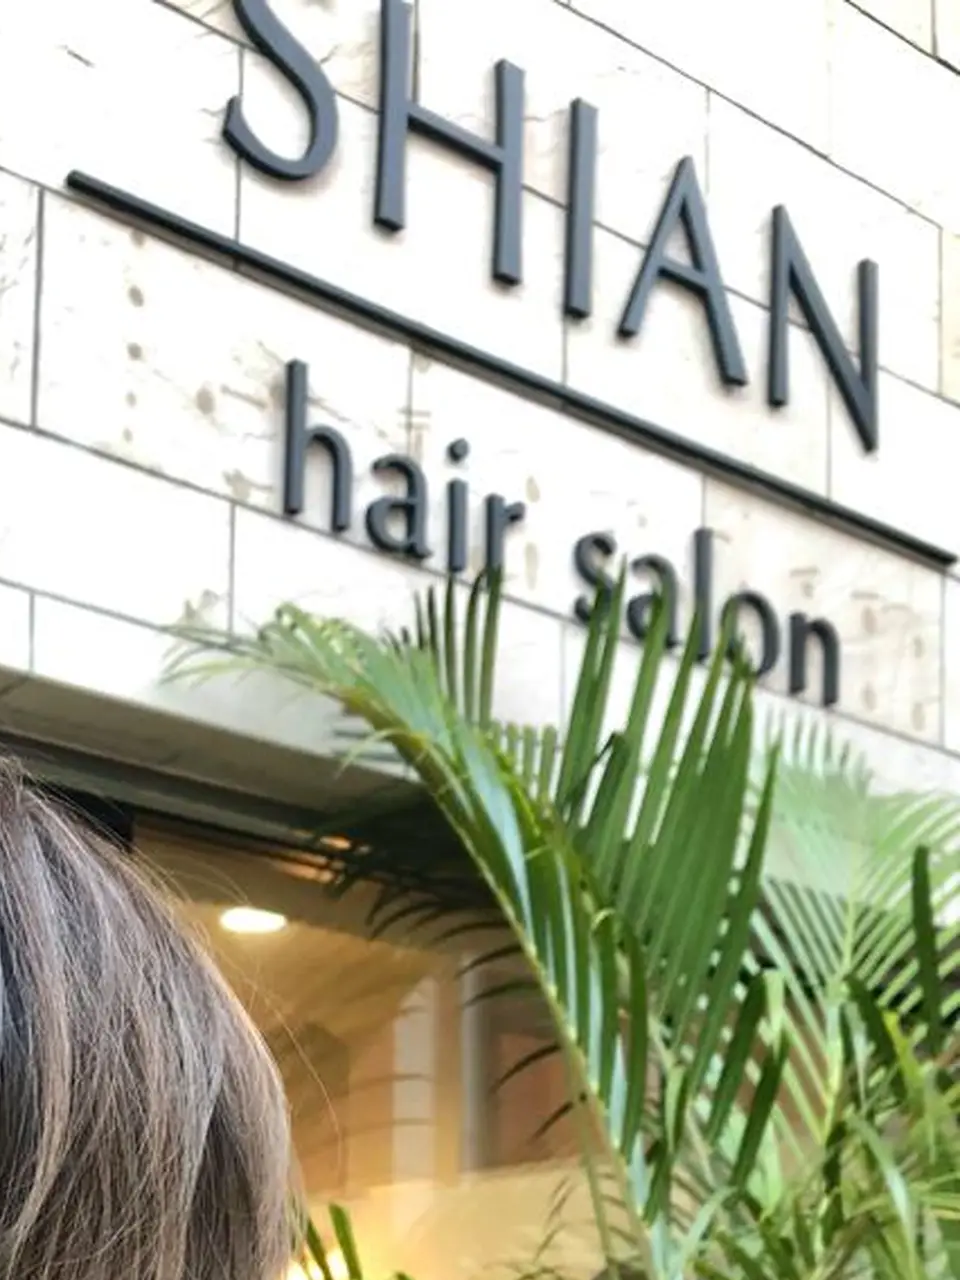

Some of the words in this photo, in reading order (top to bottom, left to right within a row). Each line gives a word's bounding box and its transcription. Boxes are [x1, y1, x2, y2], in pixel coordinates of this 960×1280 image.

[222, 0, 879, 454] SHIAN
[283, 359, 526, 580] hair
[573, 527, 839, 706] salon
